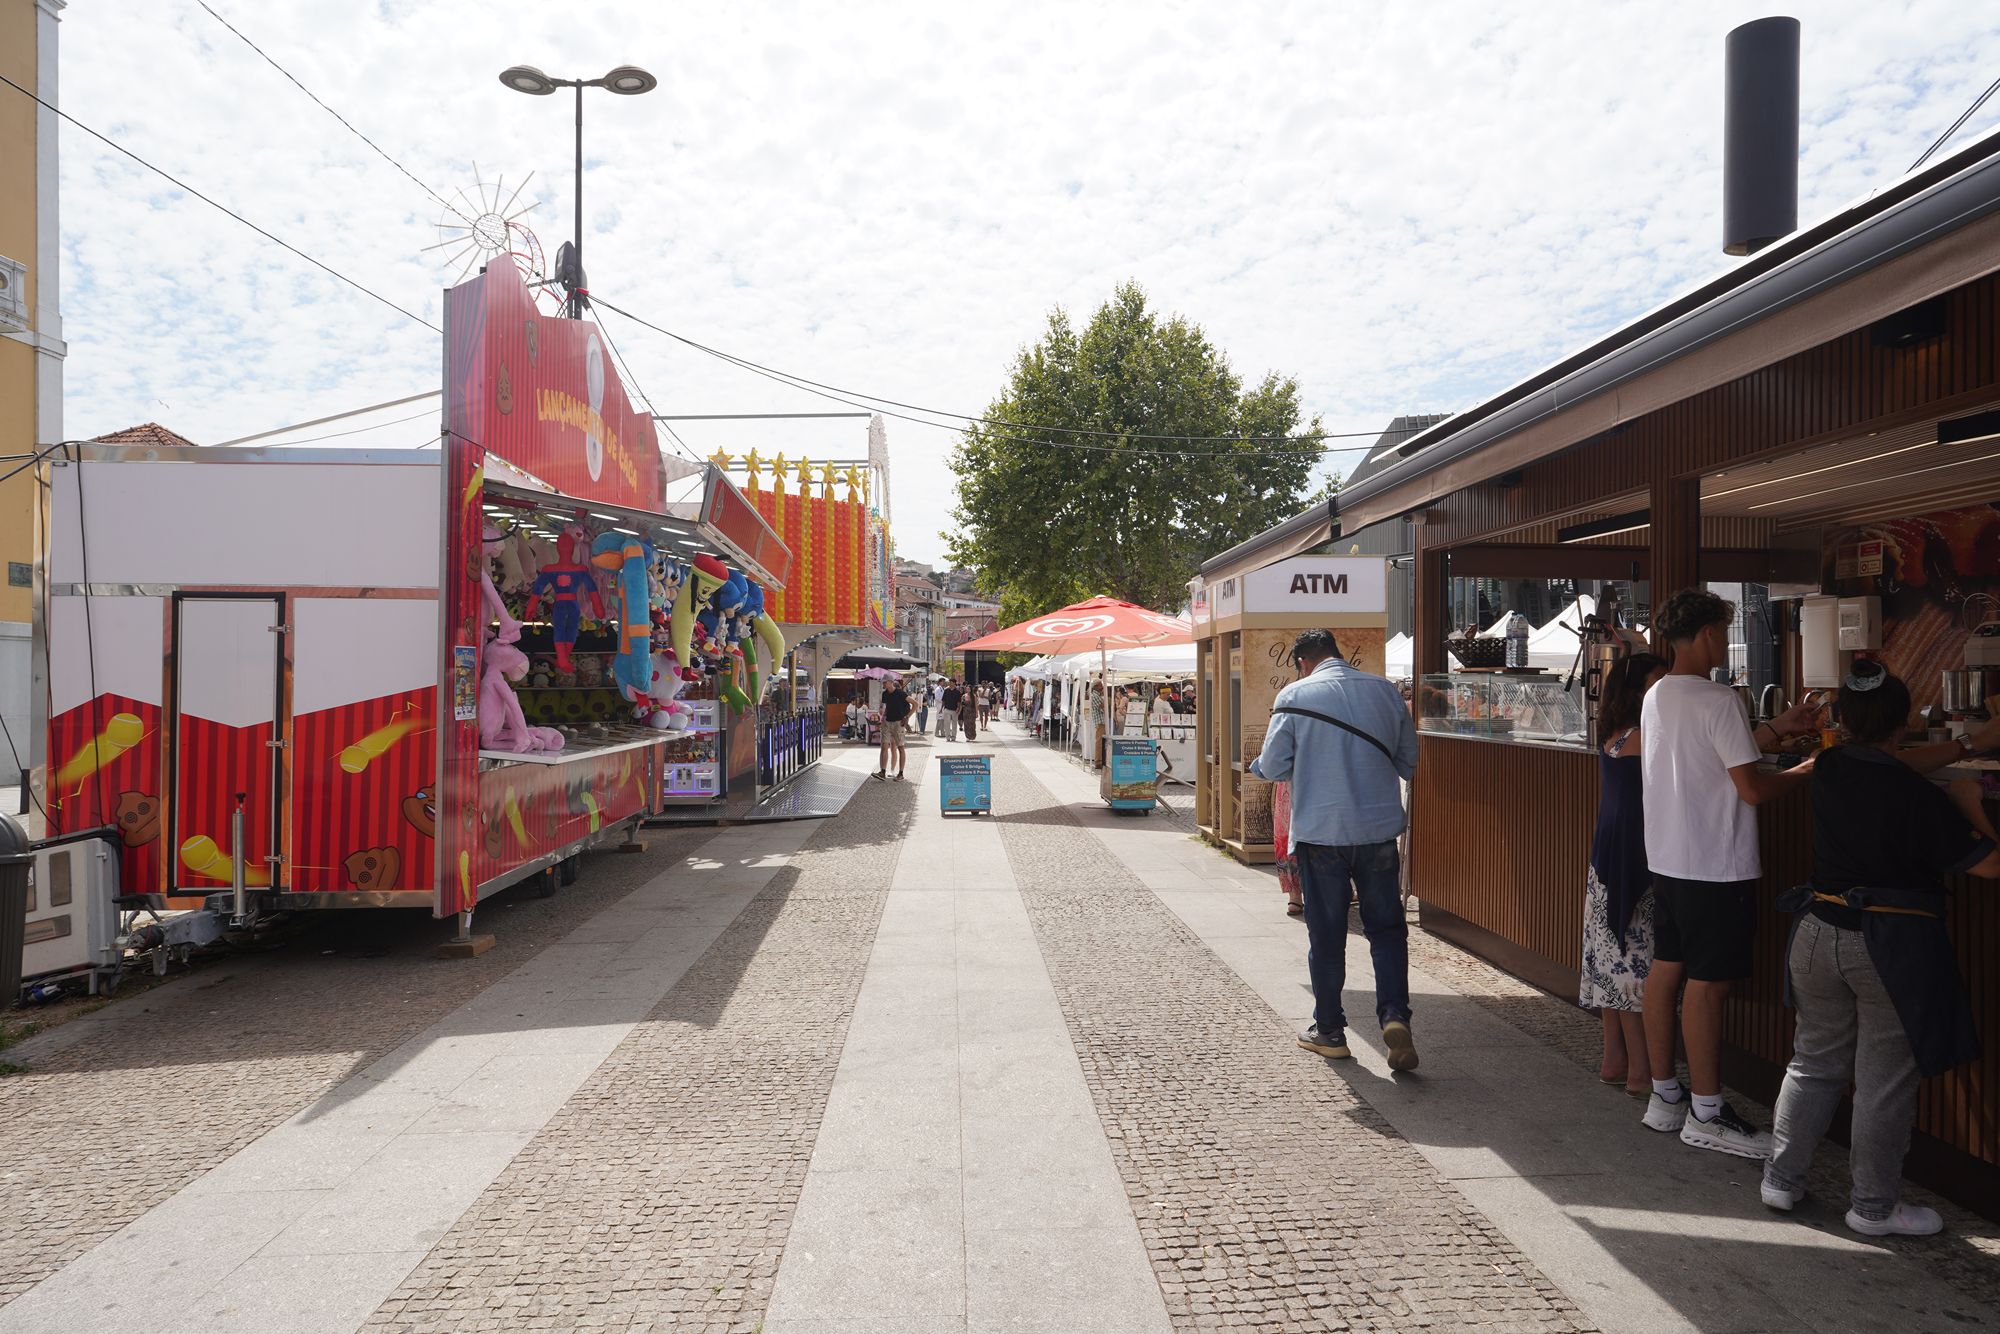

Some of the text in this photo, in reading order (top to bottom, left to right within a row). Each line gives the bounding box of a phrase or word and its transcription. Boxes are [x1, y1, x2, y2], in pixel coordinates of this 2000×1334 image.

[537, 387, 604, 445] LANÇAMENTO
[606, 426, 617, 462] DE
[1222, 578, 1236, 600] ATM
[1289, 573, 1348, 594] ATM
